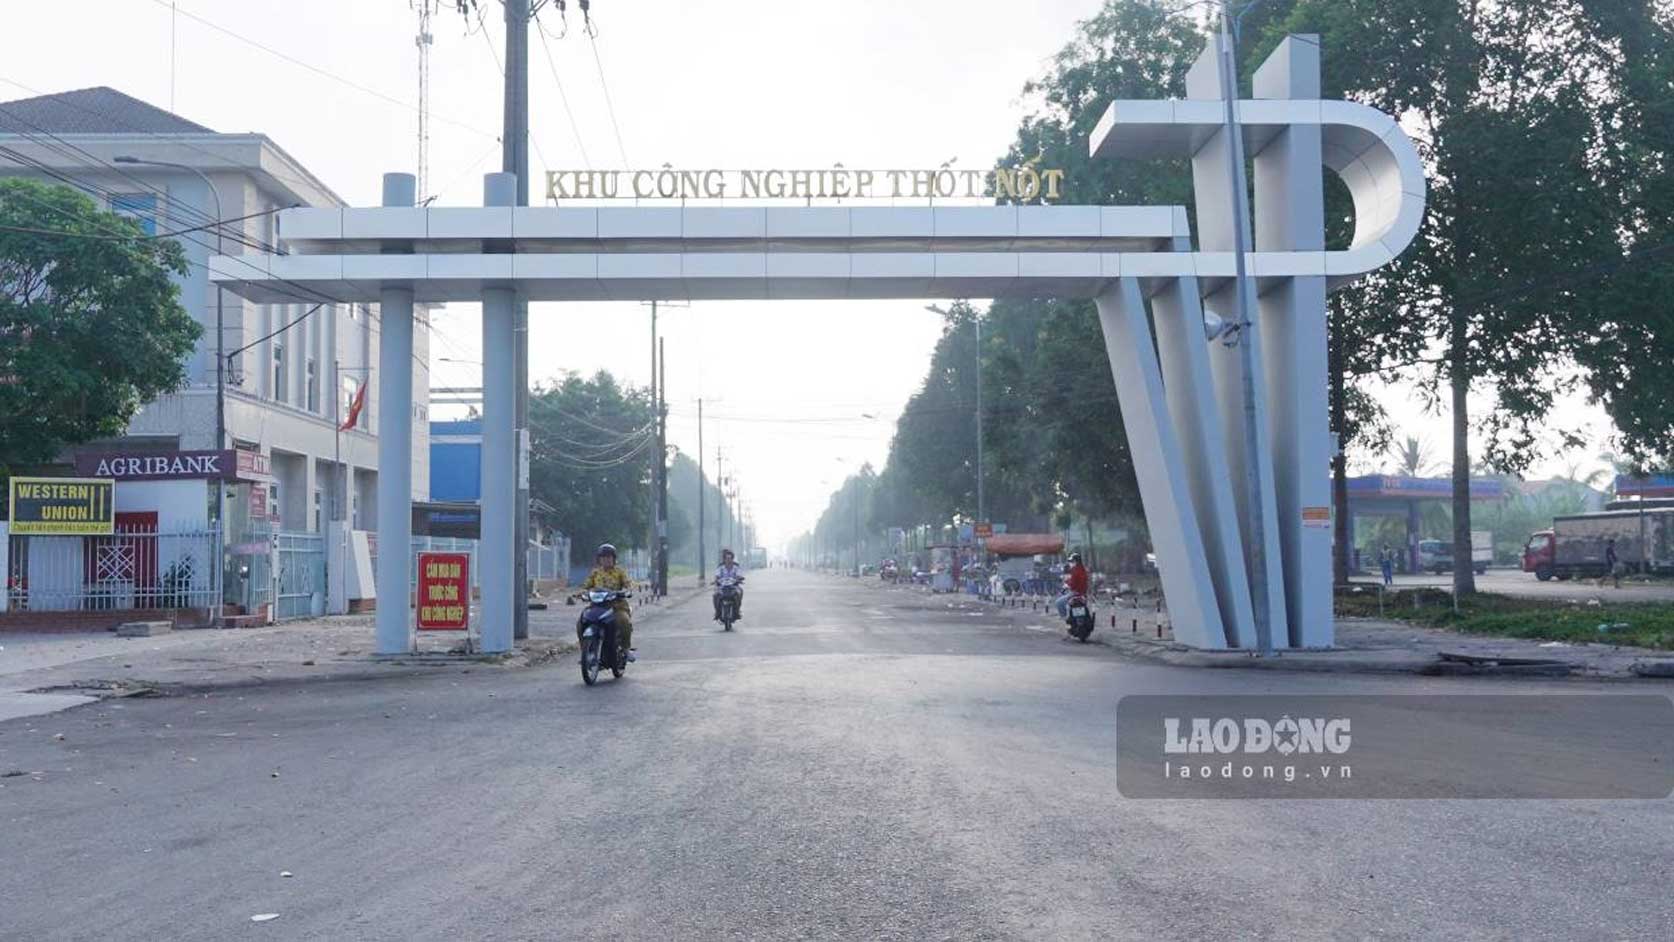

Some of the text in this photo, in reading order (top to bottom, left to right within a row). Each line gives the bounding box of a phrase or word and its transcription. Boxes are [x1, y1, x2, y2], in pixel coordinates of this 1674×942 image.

[545, 152, 1065, 202] KHU CÔNG NGHIỆP THỐT NỐT
[95, 455, 220, 476] AGRIBANK
[18, 484, 88, 499] WESTERN
[42, 505, 87, 520] UNION
